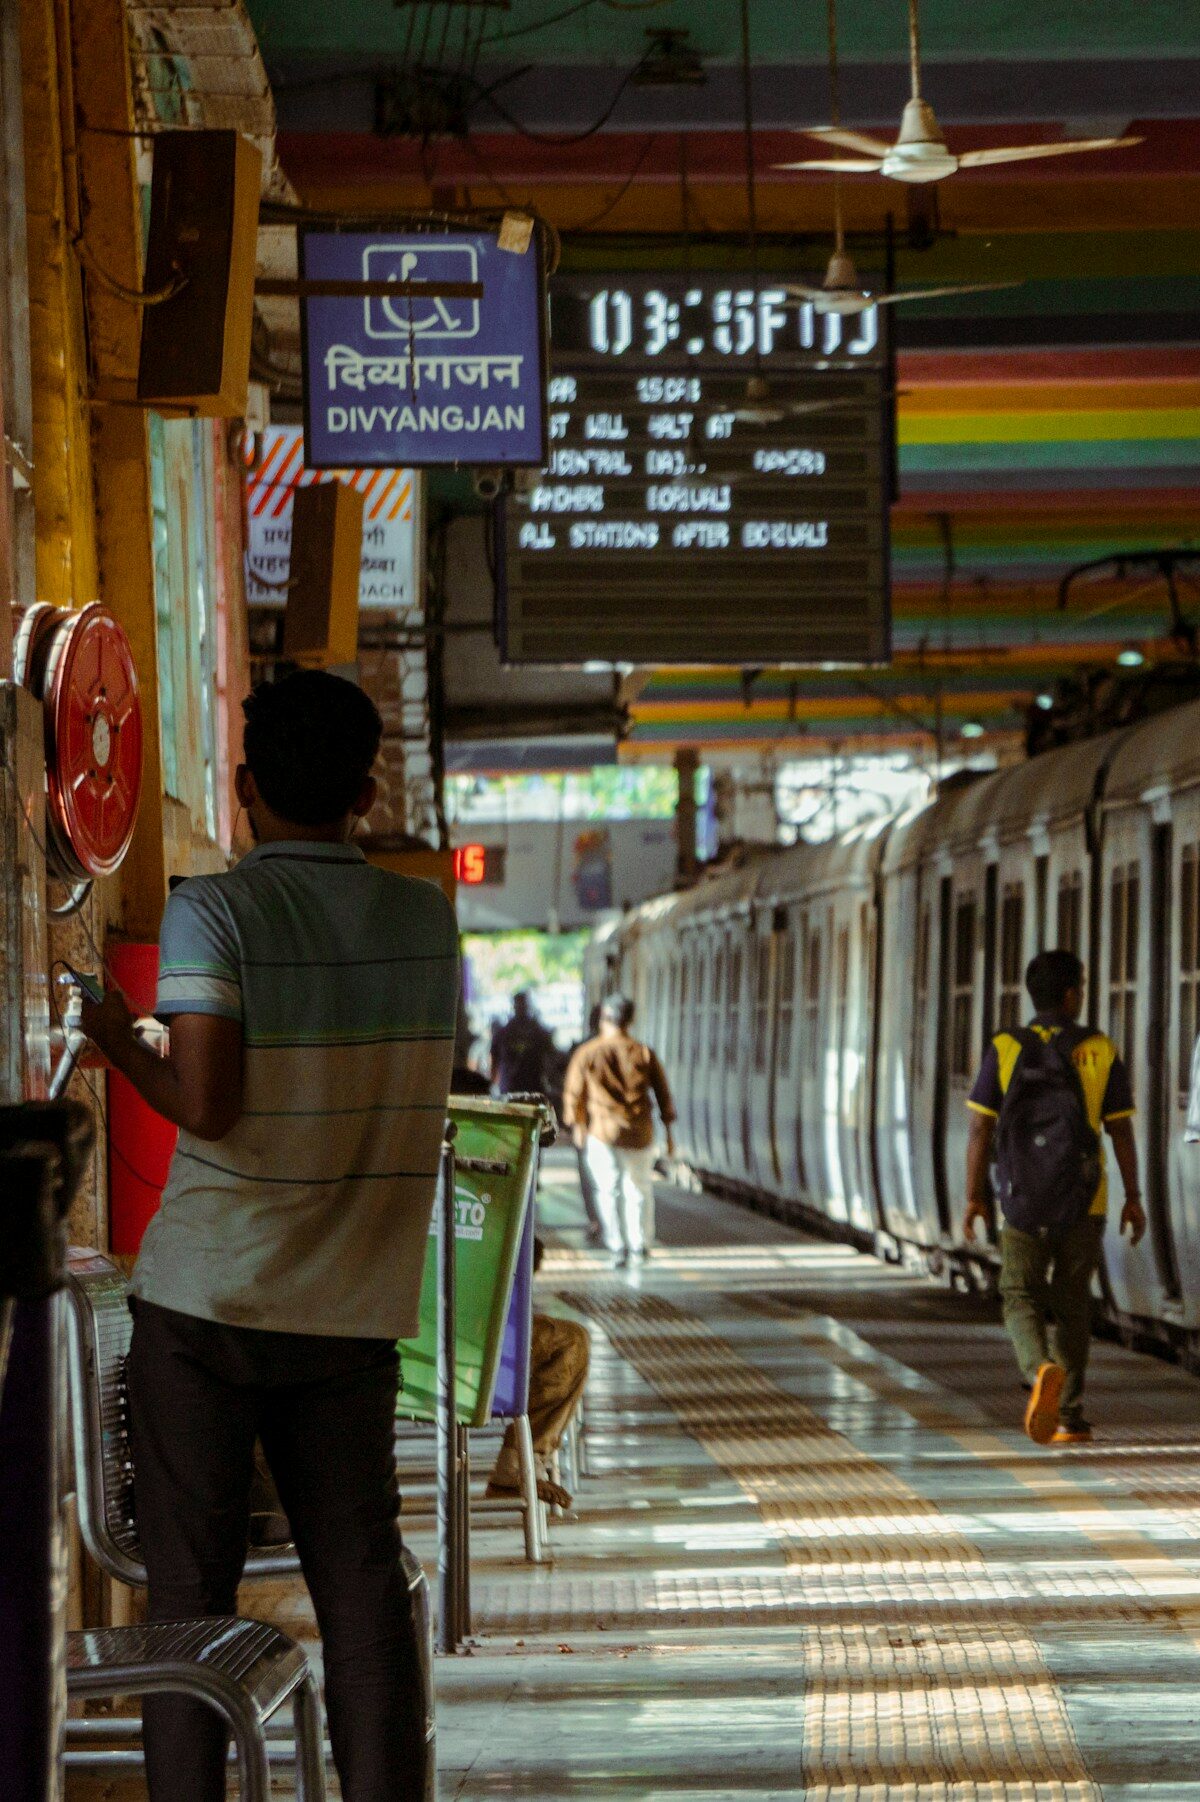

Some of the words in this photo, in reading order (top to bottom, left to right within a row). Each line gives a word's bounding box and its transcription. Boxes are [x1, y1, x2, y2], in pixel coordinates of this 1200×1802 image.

[327, 404, 526, 434] DIVYANGJAN
[584, 411, 629, 440] WILL
[704, 411, 736, 440] AT
[518, 521, 557, 550] ALL
[568, 521, 660, 550] STATIONS
[671, 520, 731, 549] AFTER
